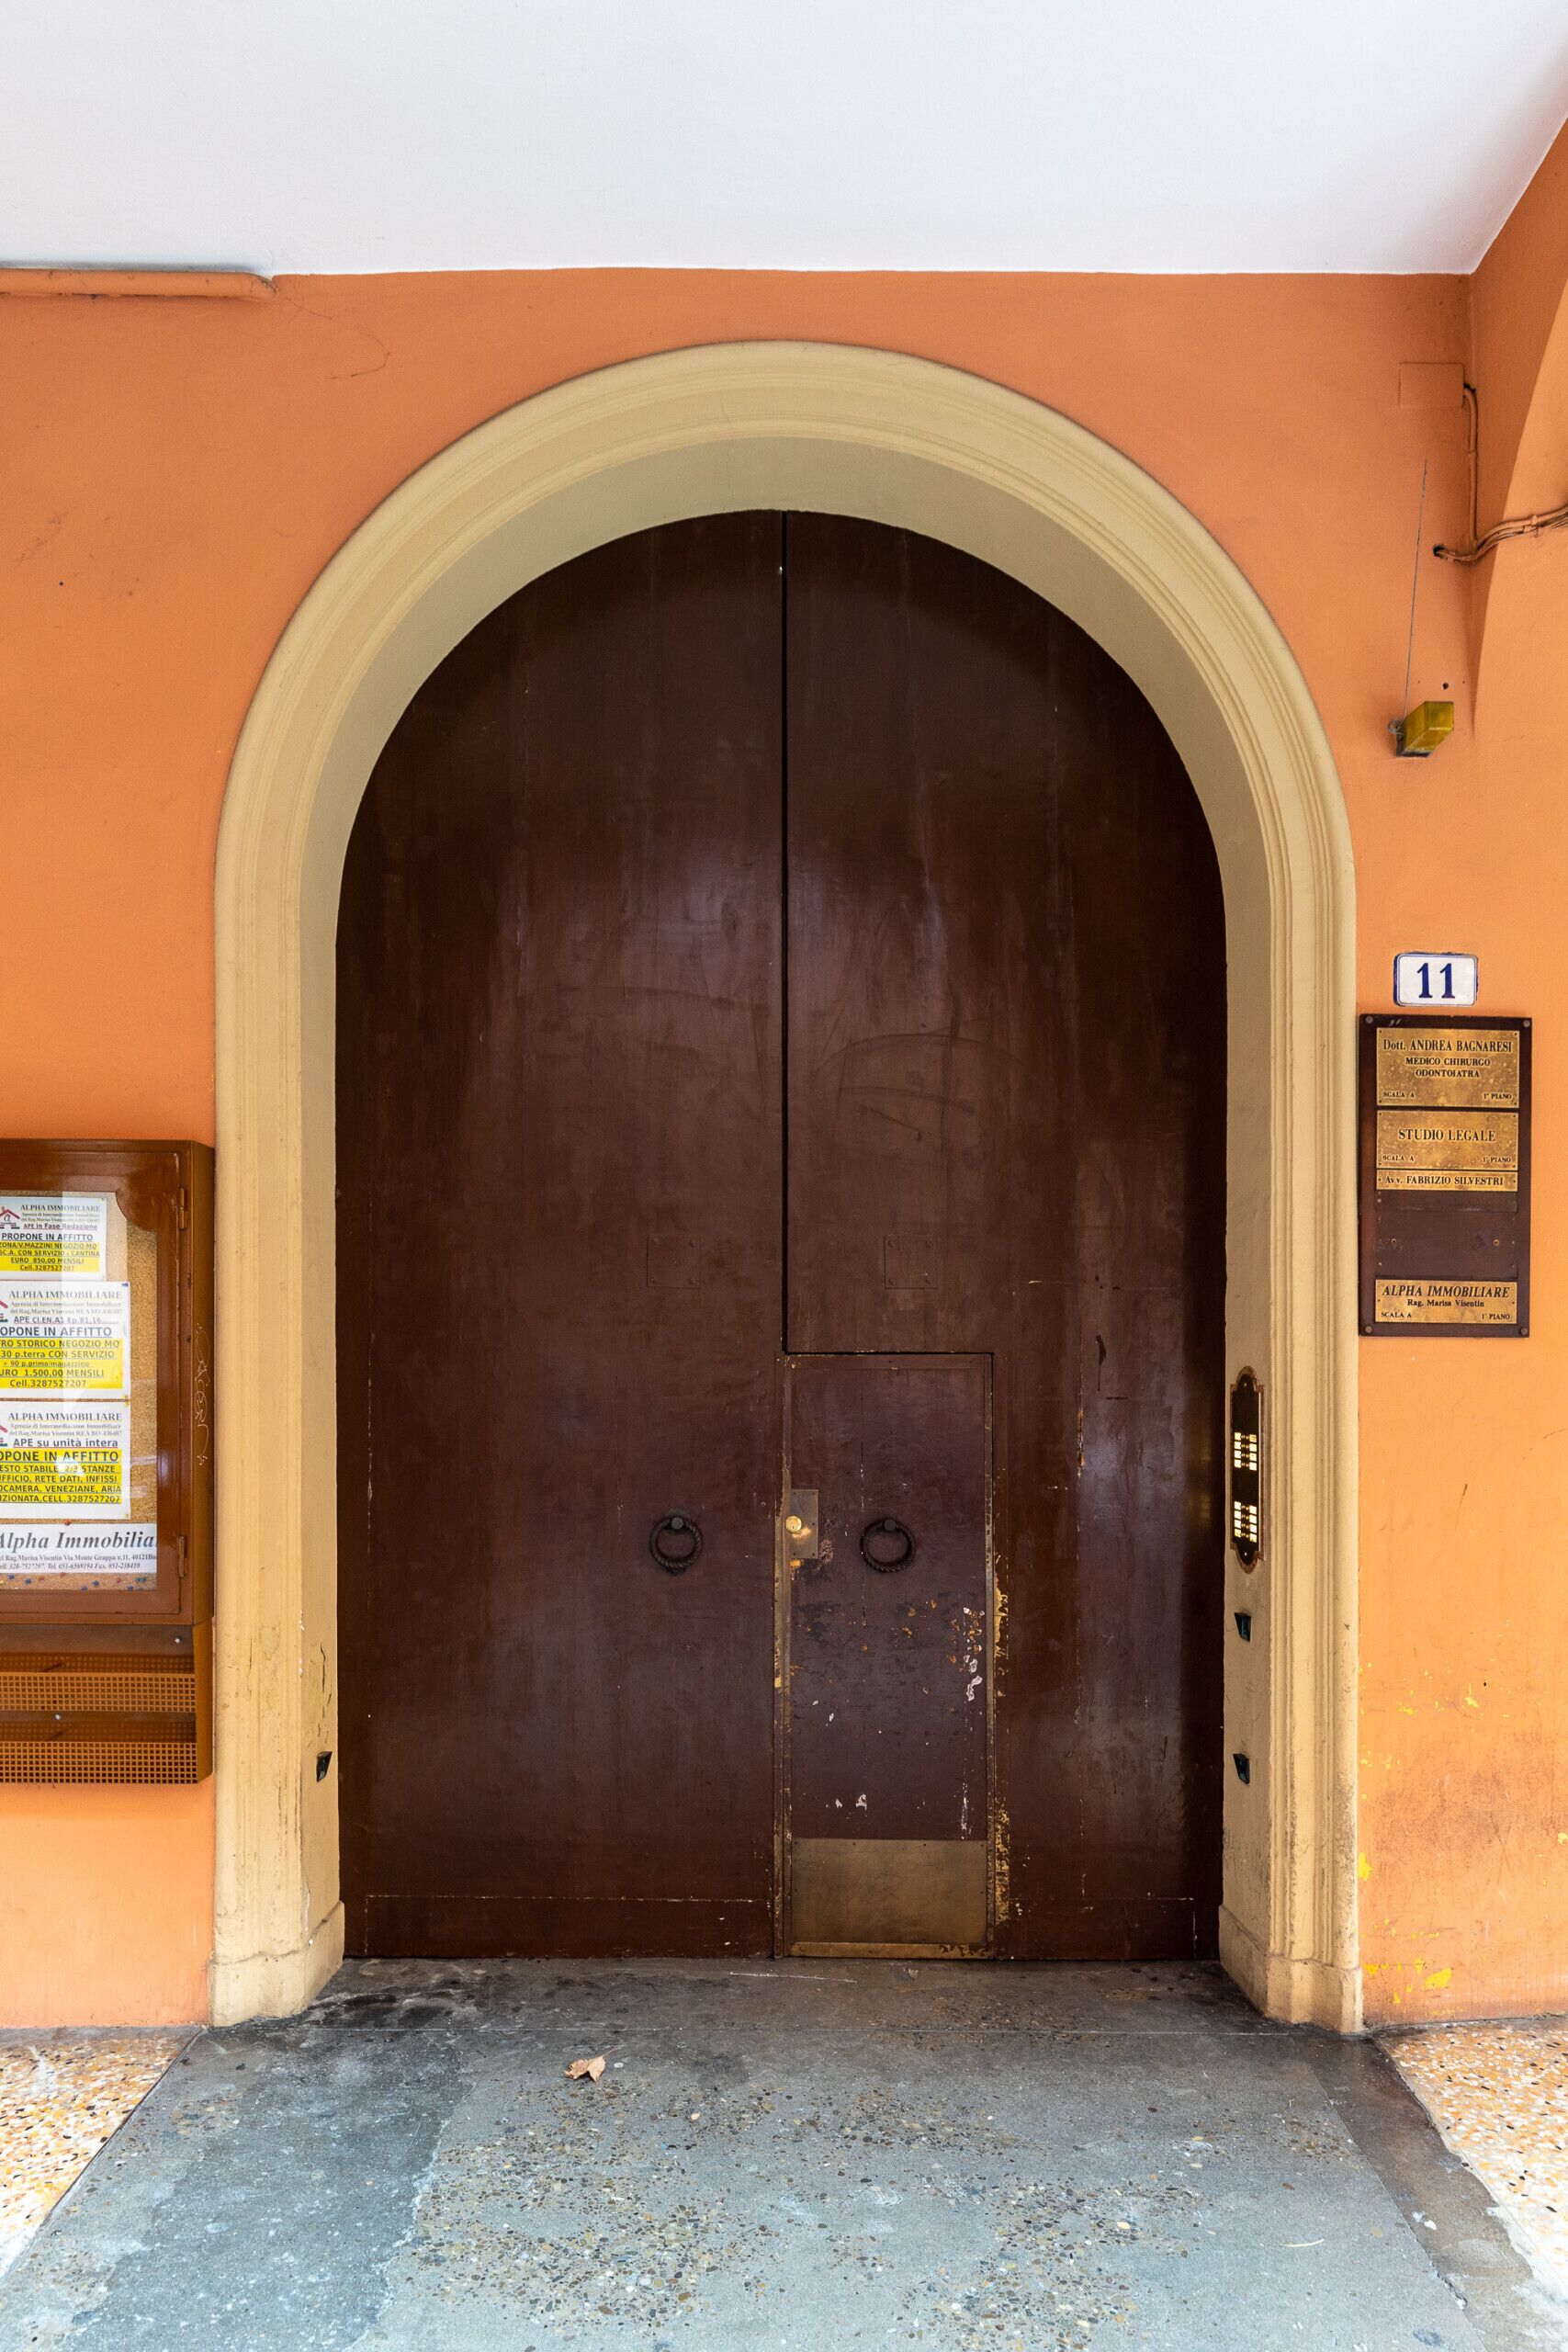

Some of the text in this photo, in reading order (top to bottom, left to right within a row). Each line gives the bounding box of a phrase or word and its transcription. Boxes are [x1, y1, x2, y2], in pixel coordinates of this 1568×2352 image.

[1416, 962, 1455, 999] 11
[1382, 1039, 1512, 1052] Dott. ANDREA BAGNARESI
[1405, 1057, 1490, 1066] MEDICO CHIRURGO
[1415, 1069, 1480, 1078] ODONTOIATRA
[1398, 1129, 1496, 1142] STUDIO LEGALE
[1406, 1176, 1451, 1184] FABRIZIO
[1454, 1176, 1504, 1185] SILVESTRI
[46, 1291, 122, 1299] IMMOBILIARE
[1382, 1285, 1510, 1298] ALPHA IMMOBILIARE
[44, 1327, 56, 1336] IN
[61, 1327, 112, 1336] AFFITTO
[53, 1438, 81, 1447] unità
[45, 1452, 57, 1461] IN
[63, 1452, 118, 1461] AFFITTO
[56, 1532, 157, 1549] Immobilia
